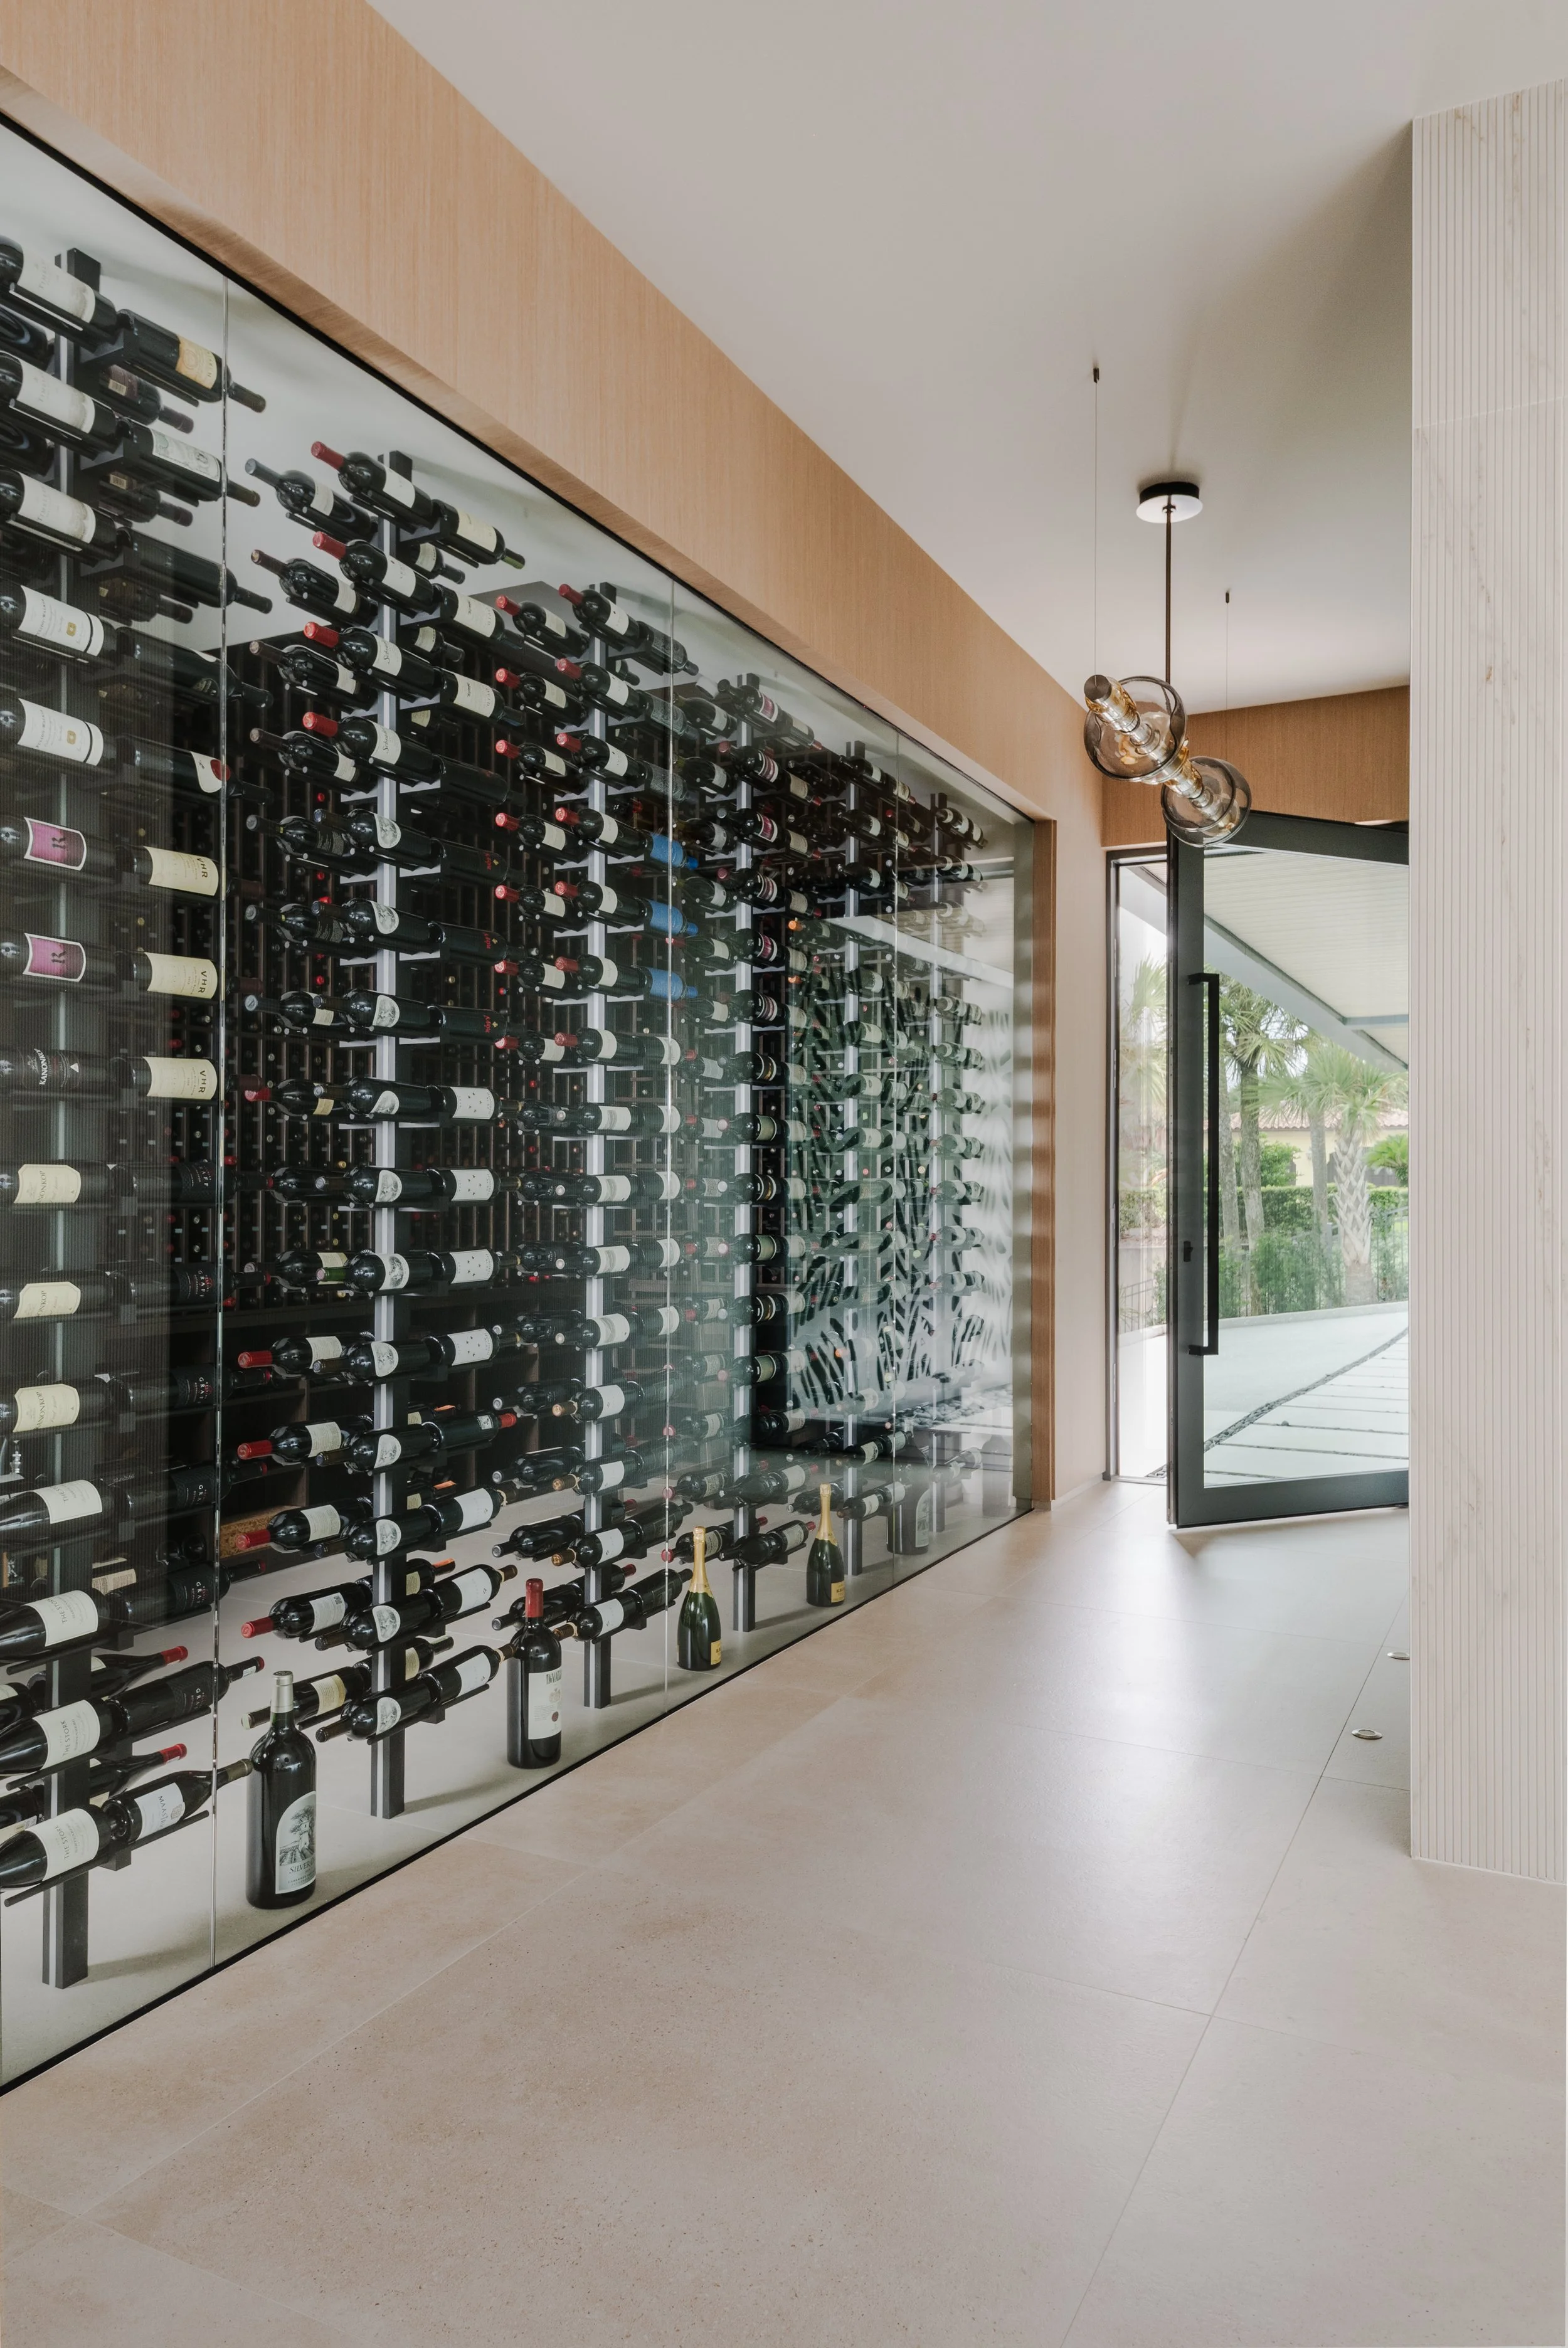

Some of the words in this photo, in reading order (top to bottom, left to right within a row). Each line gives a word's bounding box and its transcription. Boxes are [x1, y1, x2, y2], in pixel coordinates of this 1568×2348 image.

[196, 857, 208, 879] VHR
[197, 970, 208, 993] VHR
[60, 1609, 68, 1625] THE
[61, 1720, 71, 1743] STORK
[55, 1824, 70, 1845] STORK
